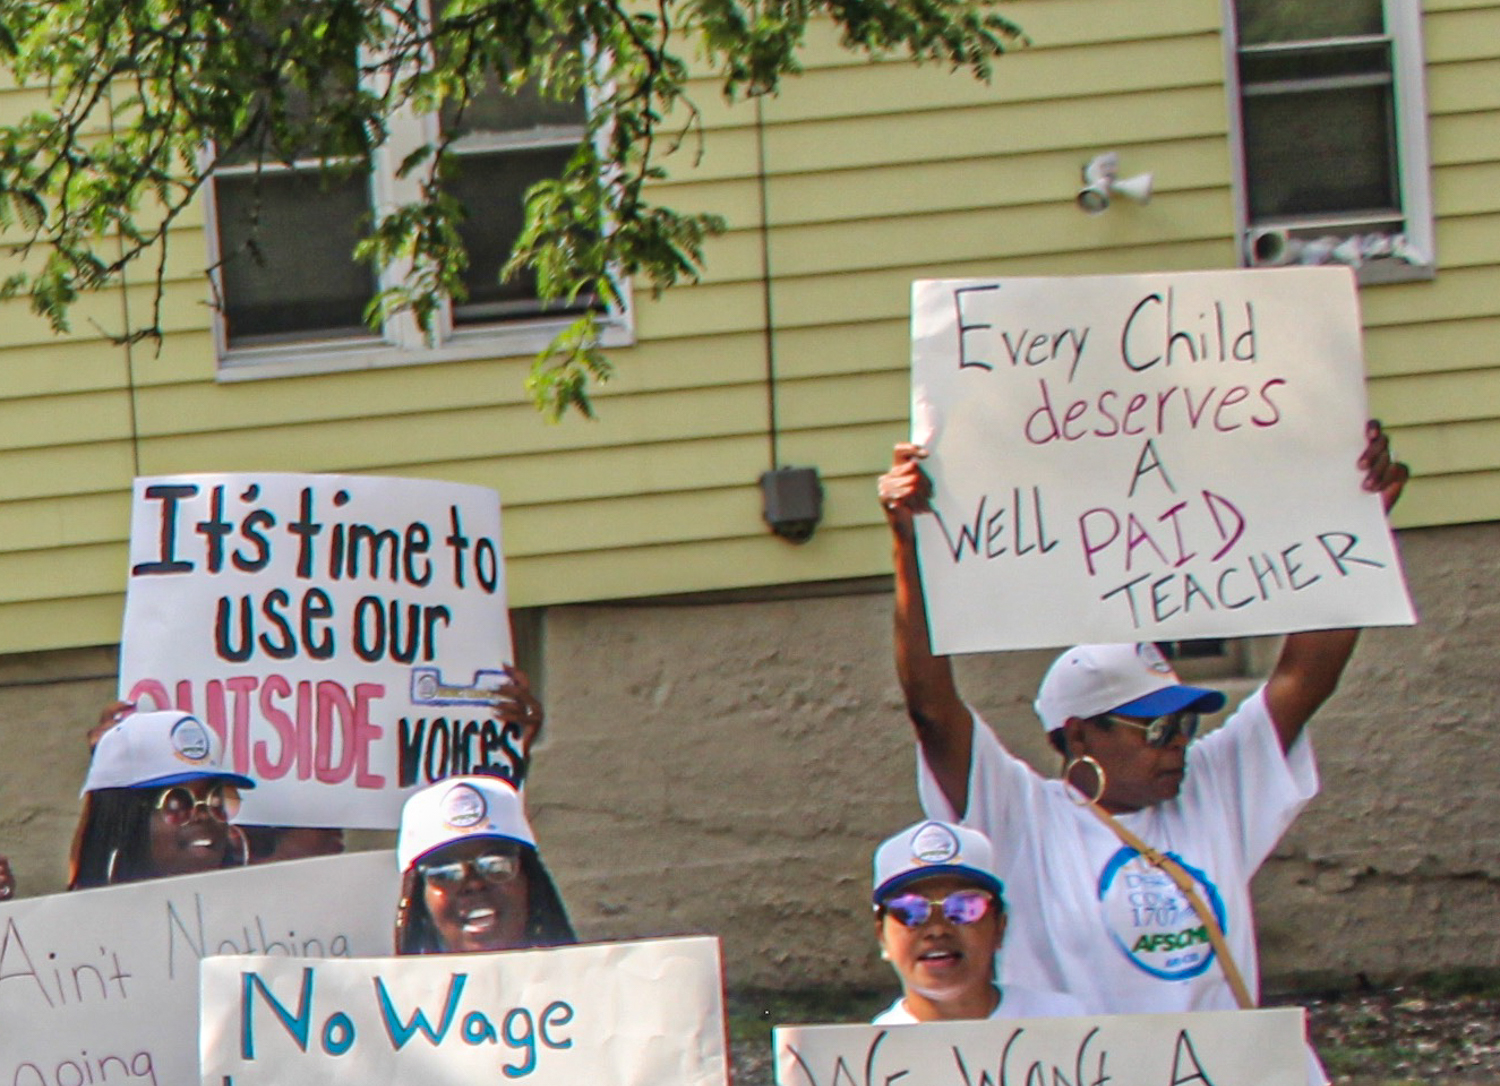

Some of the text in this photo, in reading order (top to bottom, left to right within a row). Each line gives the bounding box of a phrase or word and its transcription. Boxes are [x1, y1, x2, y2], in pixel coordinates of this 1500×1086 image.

[953, 284, 1258, 380] Every Child
[1024, 375, 1284, 447] deserves
[1126, 440, 1177, 499] A
[131, 483, 500, 593] It's time to
[931, 487, 1246, 578] WELL PAID
[214, 588, 449, 663] use our
[1100, 530, 1385, 630] TEACHER
[239, 966, 574, 1078] No Wage
